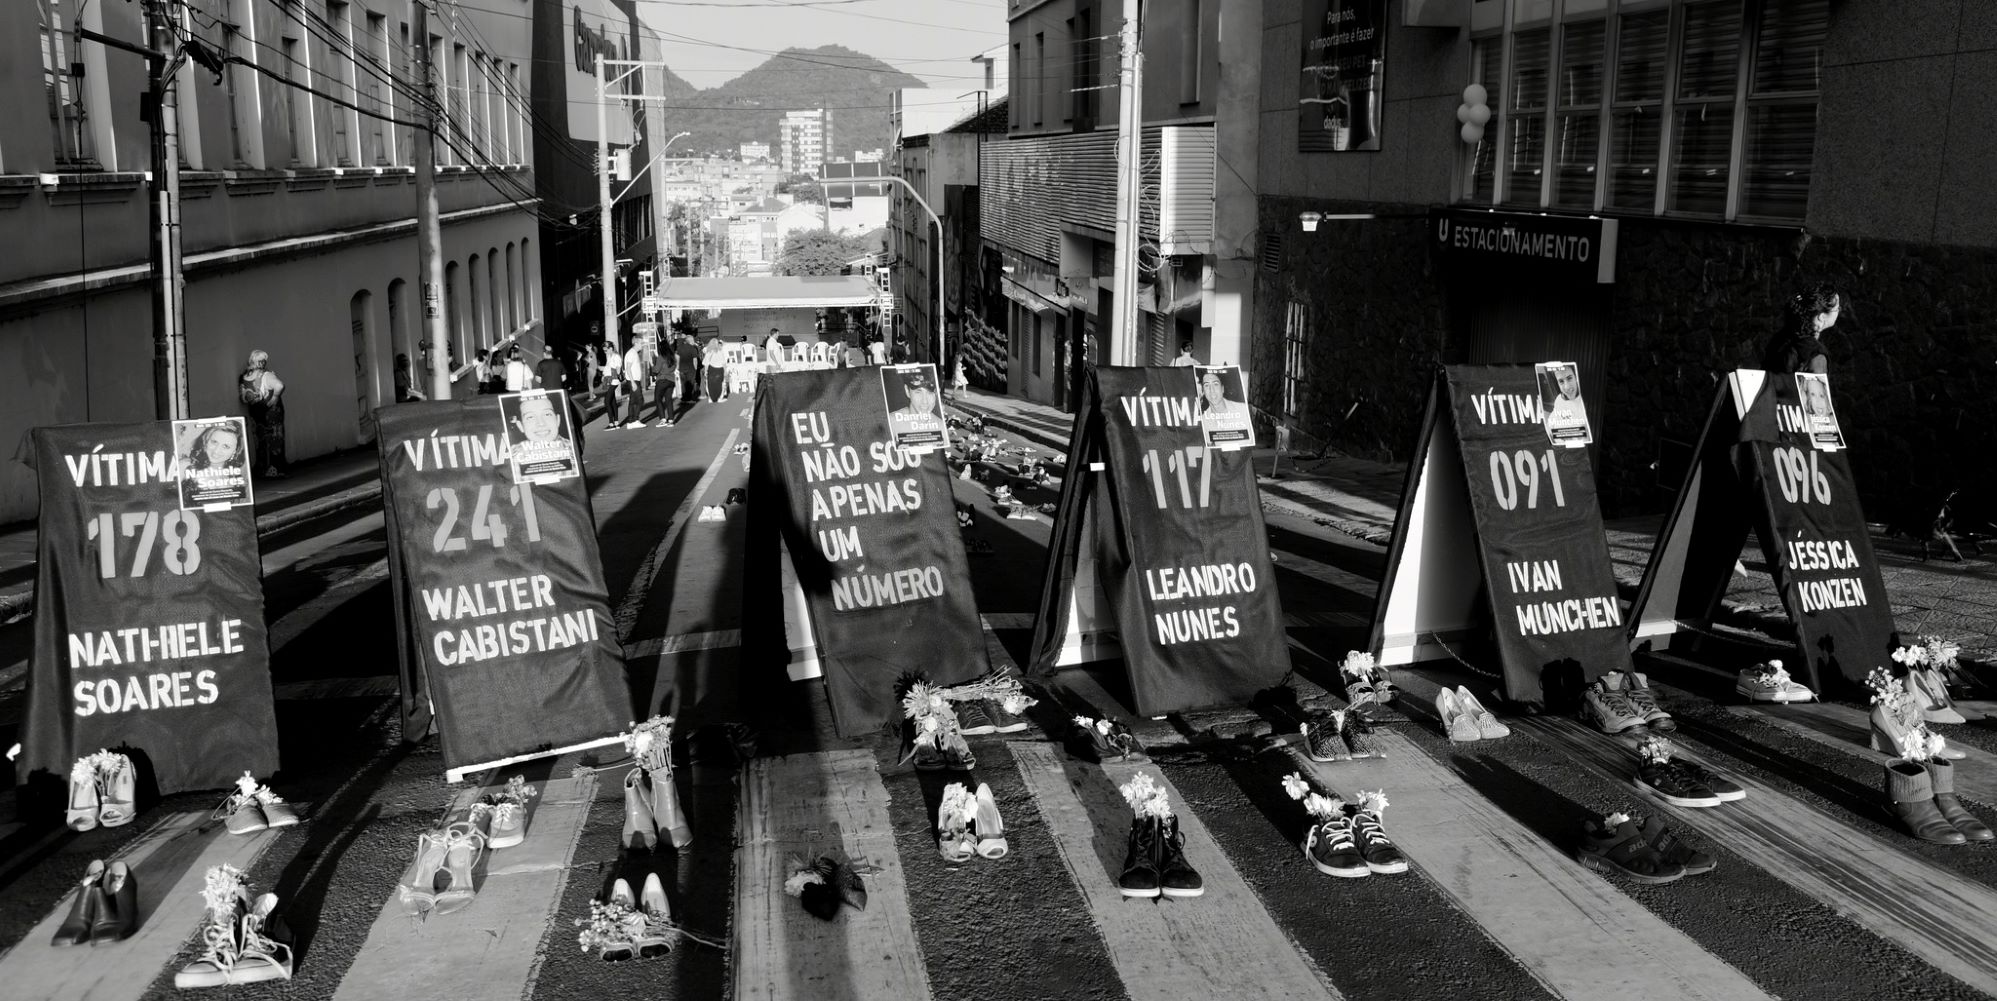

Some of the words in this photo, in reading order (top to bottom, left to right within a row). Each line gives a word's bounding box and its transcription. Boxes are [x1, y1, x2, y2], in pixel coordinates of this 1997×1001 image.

[1327, 11, 1340, 24] Para
[1315, 32, 1350, 51] importante
[1351, 28, 1356, 43] é
[1356, 26, 1375, 41] fazer
[1454, 226, 1590, 263] ESTACIONAMENTO
[792, 411, 830, 445] EU
[911, 420, 939, 431] Darin
[1204, 410, 1241, 420] Leandro
[516, 449, 571, 463] Cabistani
[520, 439, 562, 451] Walter
[802, 441, 862, 483] NÃO
[870, 441, 921, 474] SOU
[185, 465, 242, 479] Nathiele
[197, 476, 245, 488] Soares
[1143, 446, 1212, 510] 117
[1489, 449, 1565, 511] 091
[1773, 446, 1831, 506] 096
[427, 482, 541, 554] 241
[811, 478, 922, 522] APENAS
[88, 509, 202, 579] 178
[819, 526, 864, 563] UM
[1788, 529, 1860, 571] JÉSSICA
[830, 565, 944, 612] NÚMERO
[1146, 562, 1256, 602] LEANDRO
[1507, 559, 1562, 594] IVAN
[1798, 577, 1868, 613] KONZEN
[422, 574, 555, 622] WALTER
[1516, 595, 1621, 636] MUNCHEN
[68, 619, 244, 668] NATHIELE
[434, 609, 599, 667] CABISTANI
[1155, 606, 1240, 646] NUNES
[74, 670, 219, 717] SOARES
